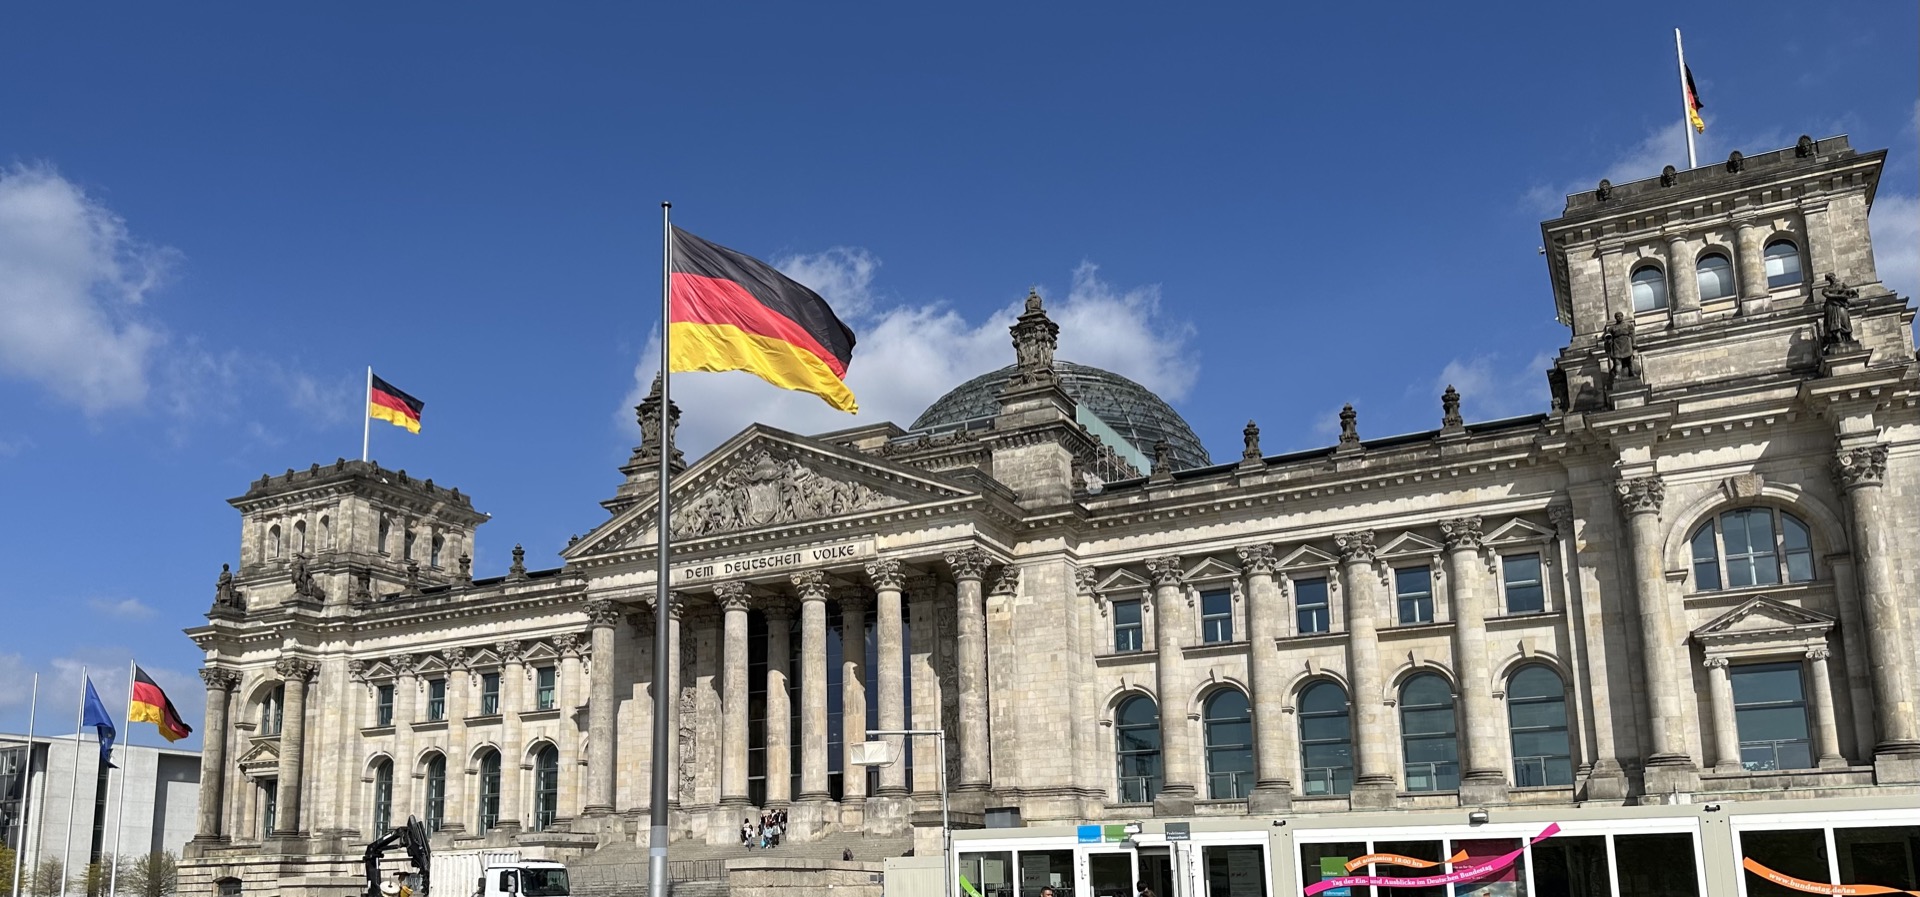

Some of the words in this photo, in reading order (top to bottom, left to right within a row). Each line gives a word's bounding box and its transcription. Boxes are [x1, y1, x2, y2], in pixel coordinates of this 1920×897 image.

[686, 565, 714, 579] DEM
[724, 553, 801, 574] DEUTSCHEN
[813, 544, 855, 561] VOLKE
[1351, 860, 1362, 868] last
[1394, 857, 1411, 865] 18:00
[1412, 859, 1423, 867] hrs
[1426, 874, 1459, 885] Deutschen
[1459, 864, 1494, 879] Bundestag
